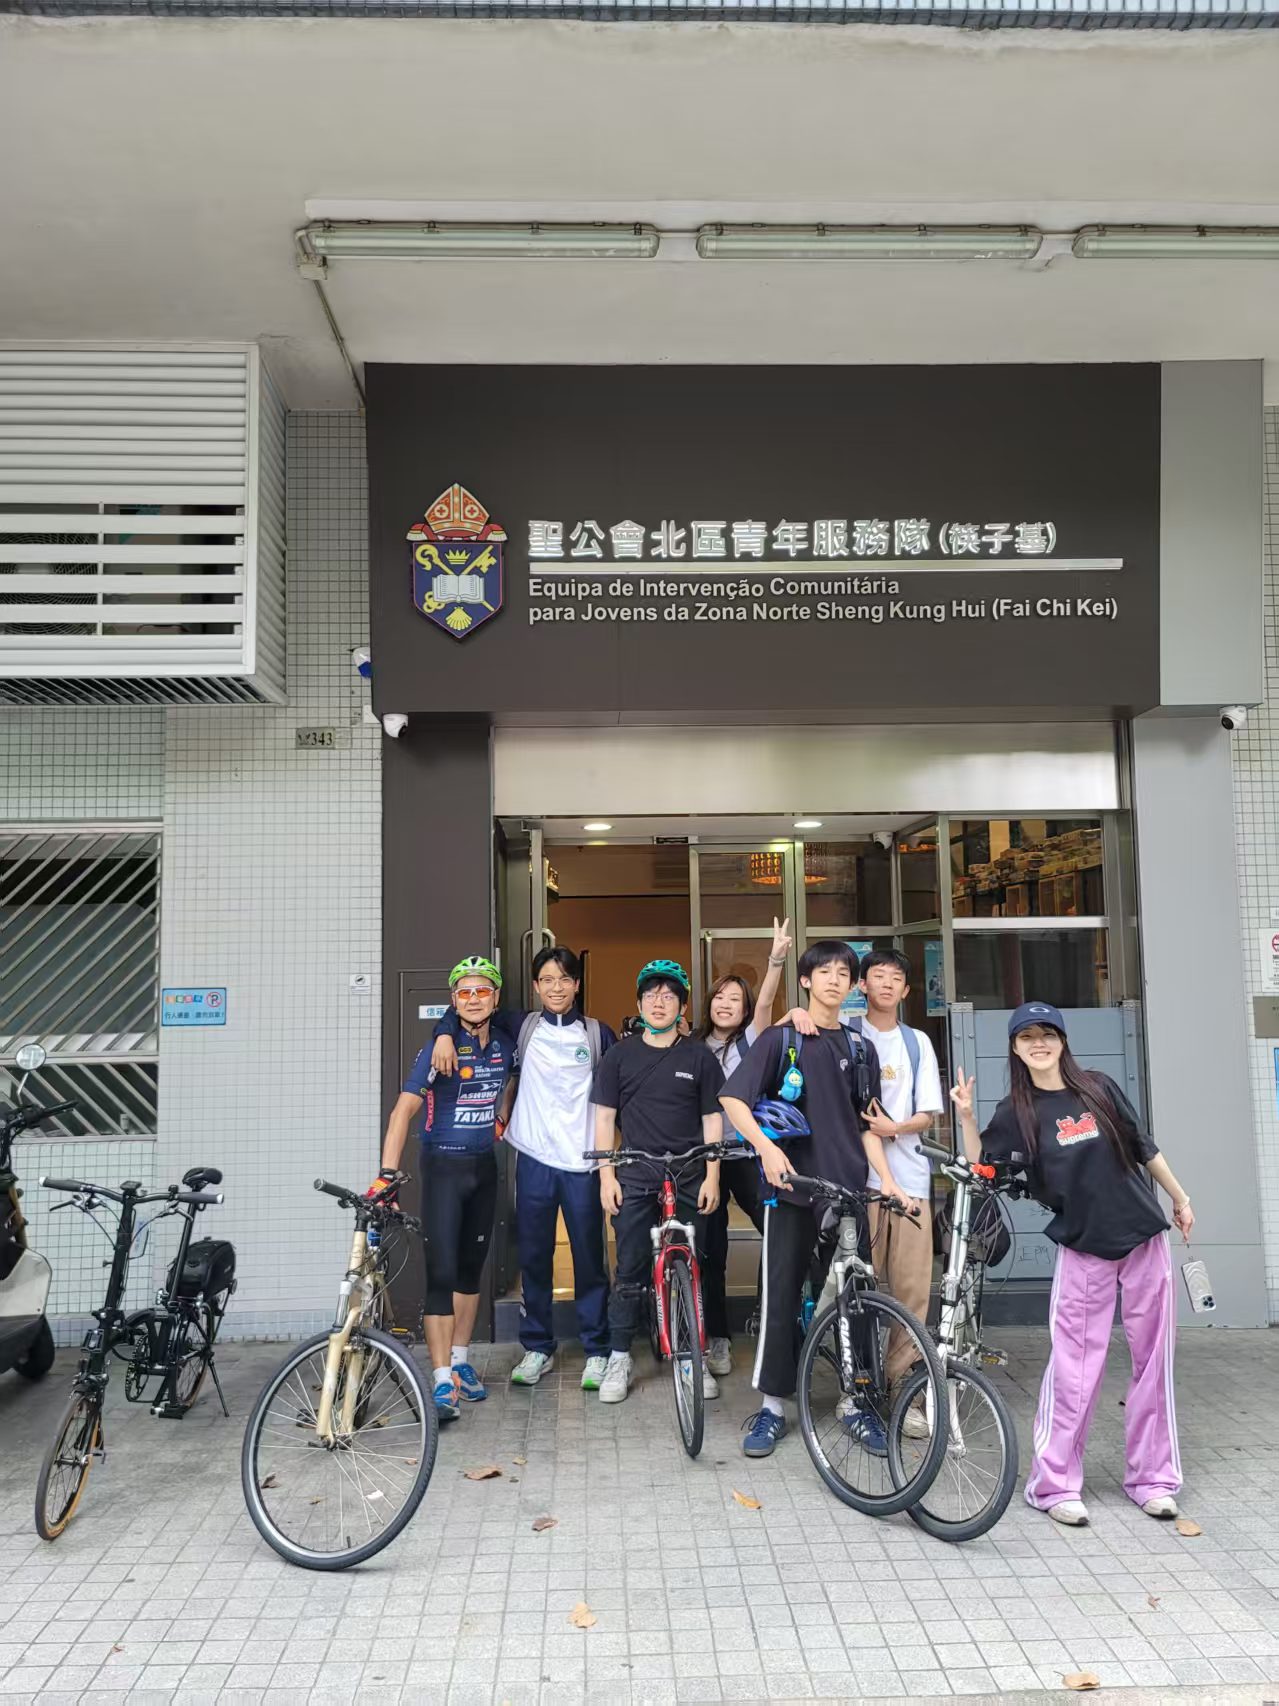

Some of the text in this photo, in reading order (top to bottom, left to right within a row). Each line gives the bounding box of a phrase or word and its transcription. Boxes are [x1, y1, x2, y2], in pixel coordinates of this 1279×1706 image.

[529, 576, 900, 600] Equipa de Intervenção Comunitária
[529, 597, 1118, 625] para Jovens da Zona Norte Sheng Kung Hui (Fai Chi Kei)
[311, 732, 333, 746] 343
